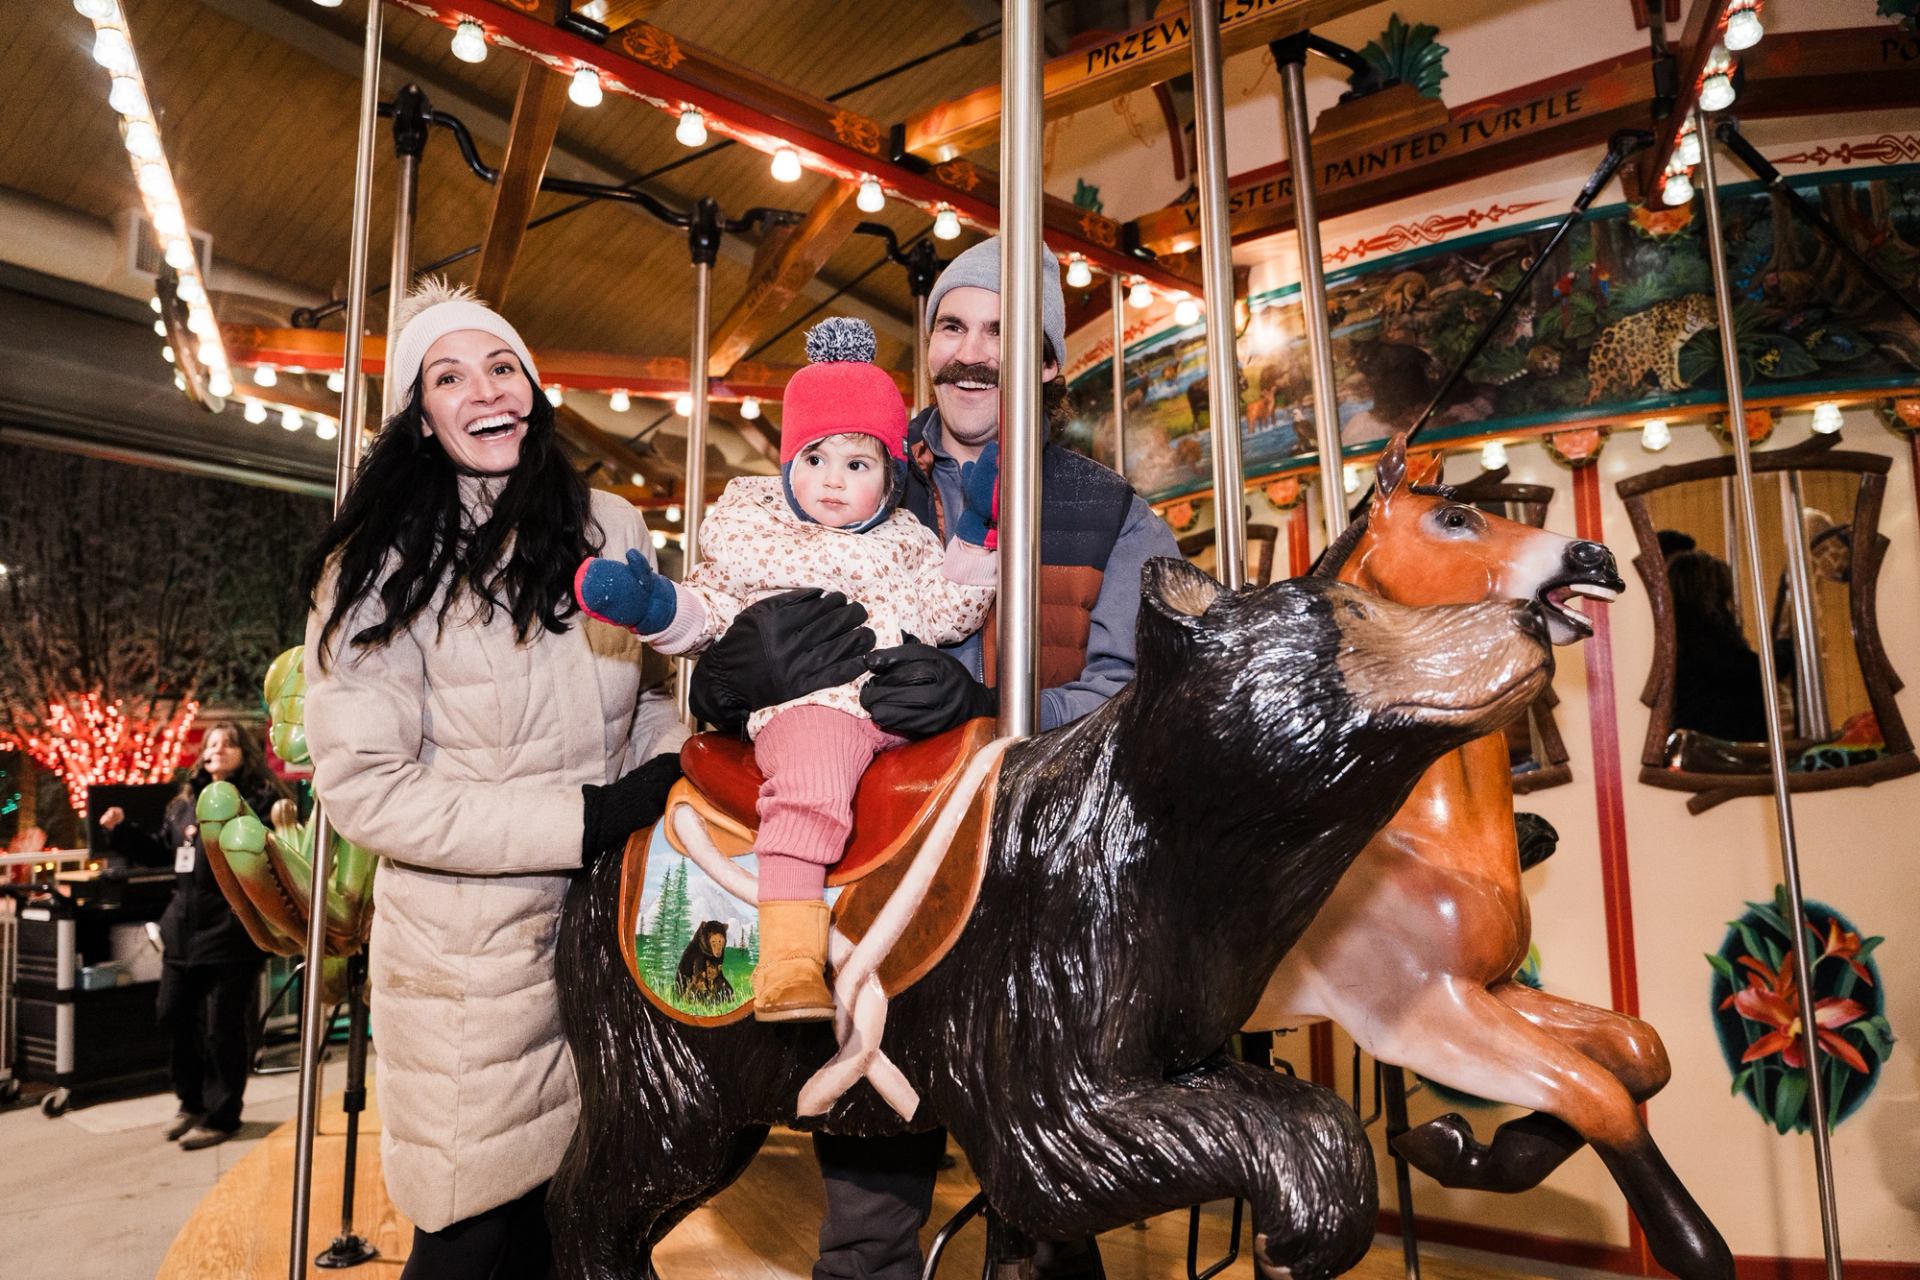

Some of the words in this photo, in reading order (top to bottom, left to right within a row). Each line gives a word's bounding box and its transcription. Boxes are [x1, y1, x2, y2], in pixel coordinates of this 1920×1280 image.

[1087, 0, 1277, 75] PRZEWLS
[1185, 176, 1293, 226] WSTER
[1324, 132, 1447, 185] PAINTED
[1458, 87, 1583, 145] TURTLE
